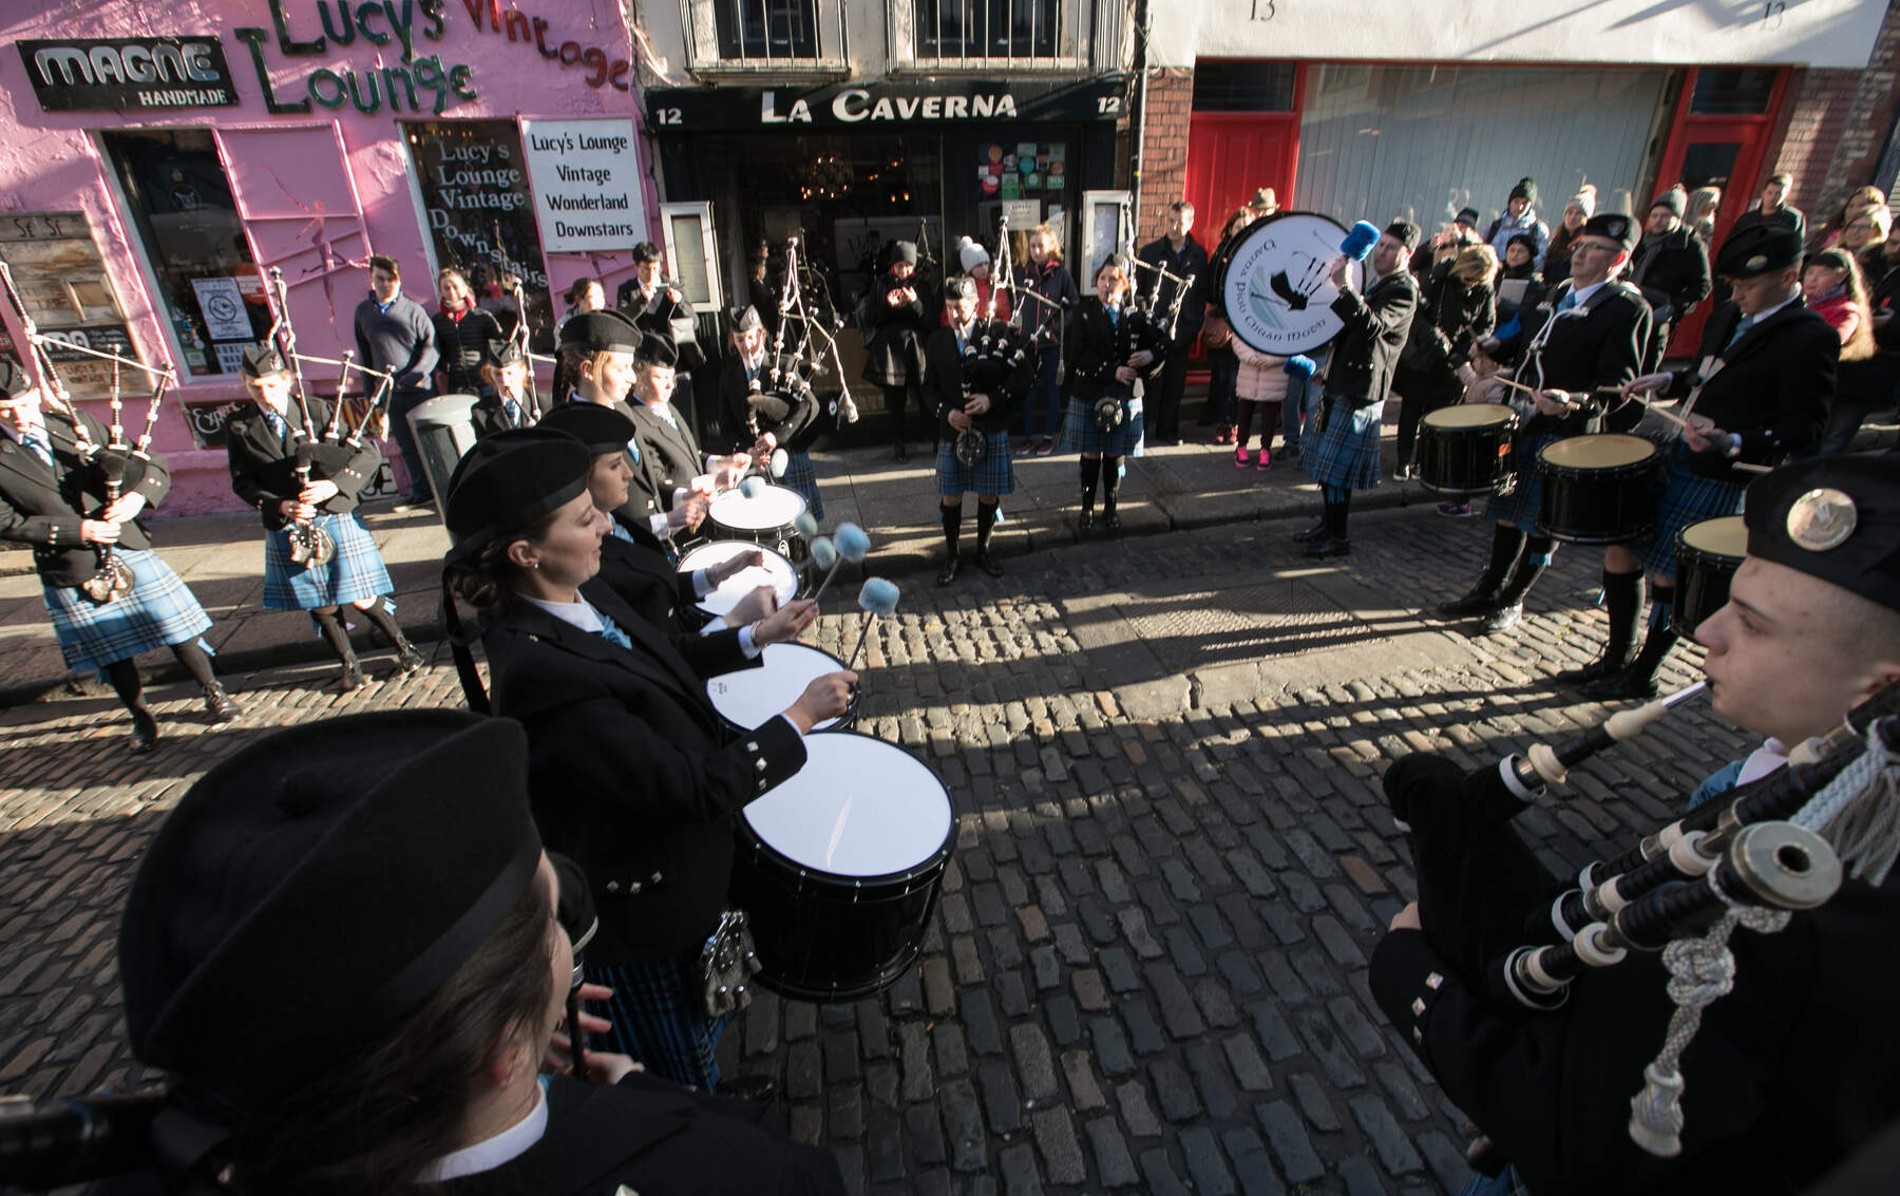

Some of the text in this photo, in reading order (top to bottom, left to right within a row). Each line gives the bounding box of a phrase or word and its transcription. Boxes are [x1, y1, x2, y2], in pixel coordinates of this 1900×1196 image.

[1250, 0, 1276, 22] 13
[234, 28, 478, 116] Lounge
[138, 89, 228, 106] HANDMADE
[1096, 96, 1121, 114] 12
[656, 107, 683, 125] 12
[438, 139, 510, 164] Lucy's
[532, 132, 629, 155] Lucy's Lounge
[438, 164, 522, 188] Lounge
[556, 164, 612, 186] Vintage
[438, 188, 526, 211] Vintage
[546, 192, 629, 211] Wonderland
[555, 221, 634, 238] Downstairs
[429, 208, 549, 288] Downstairs
